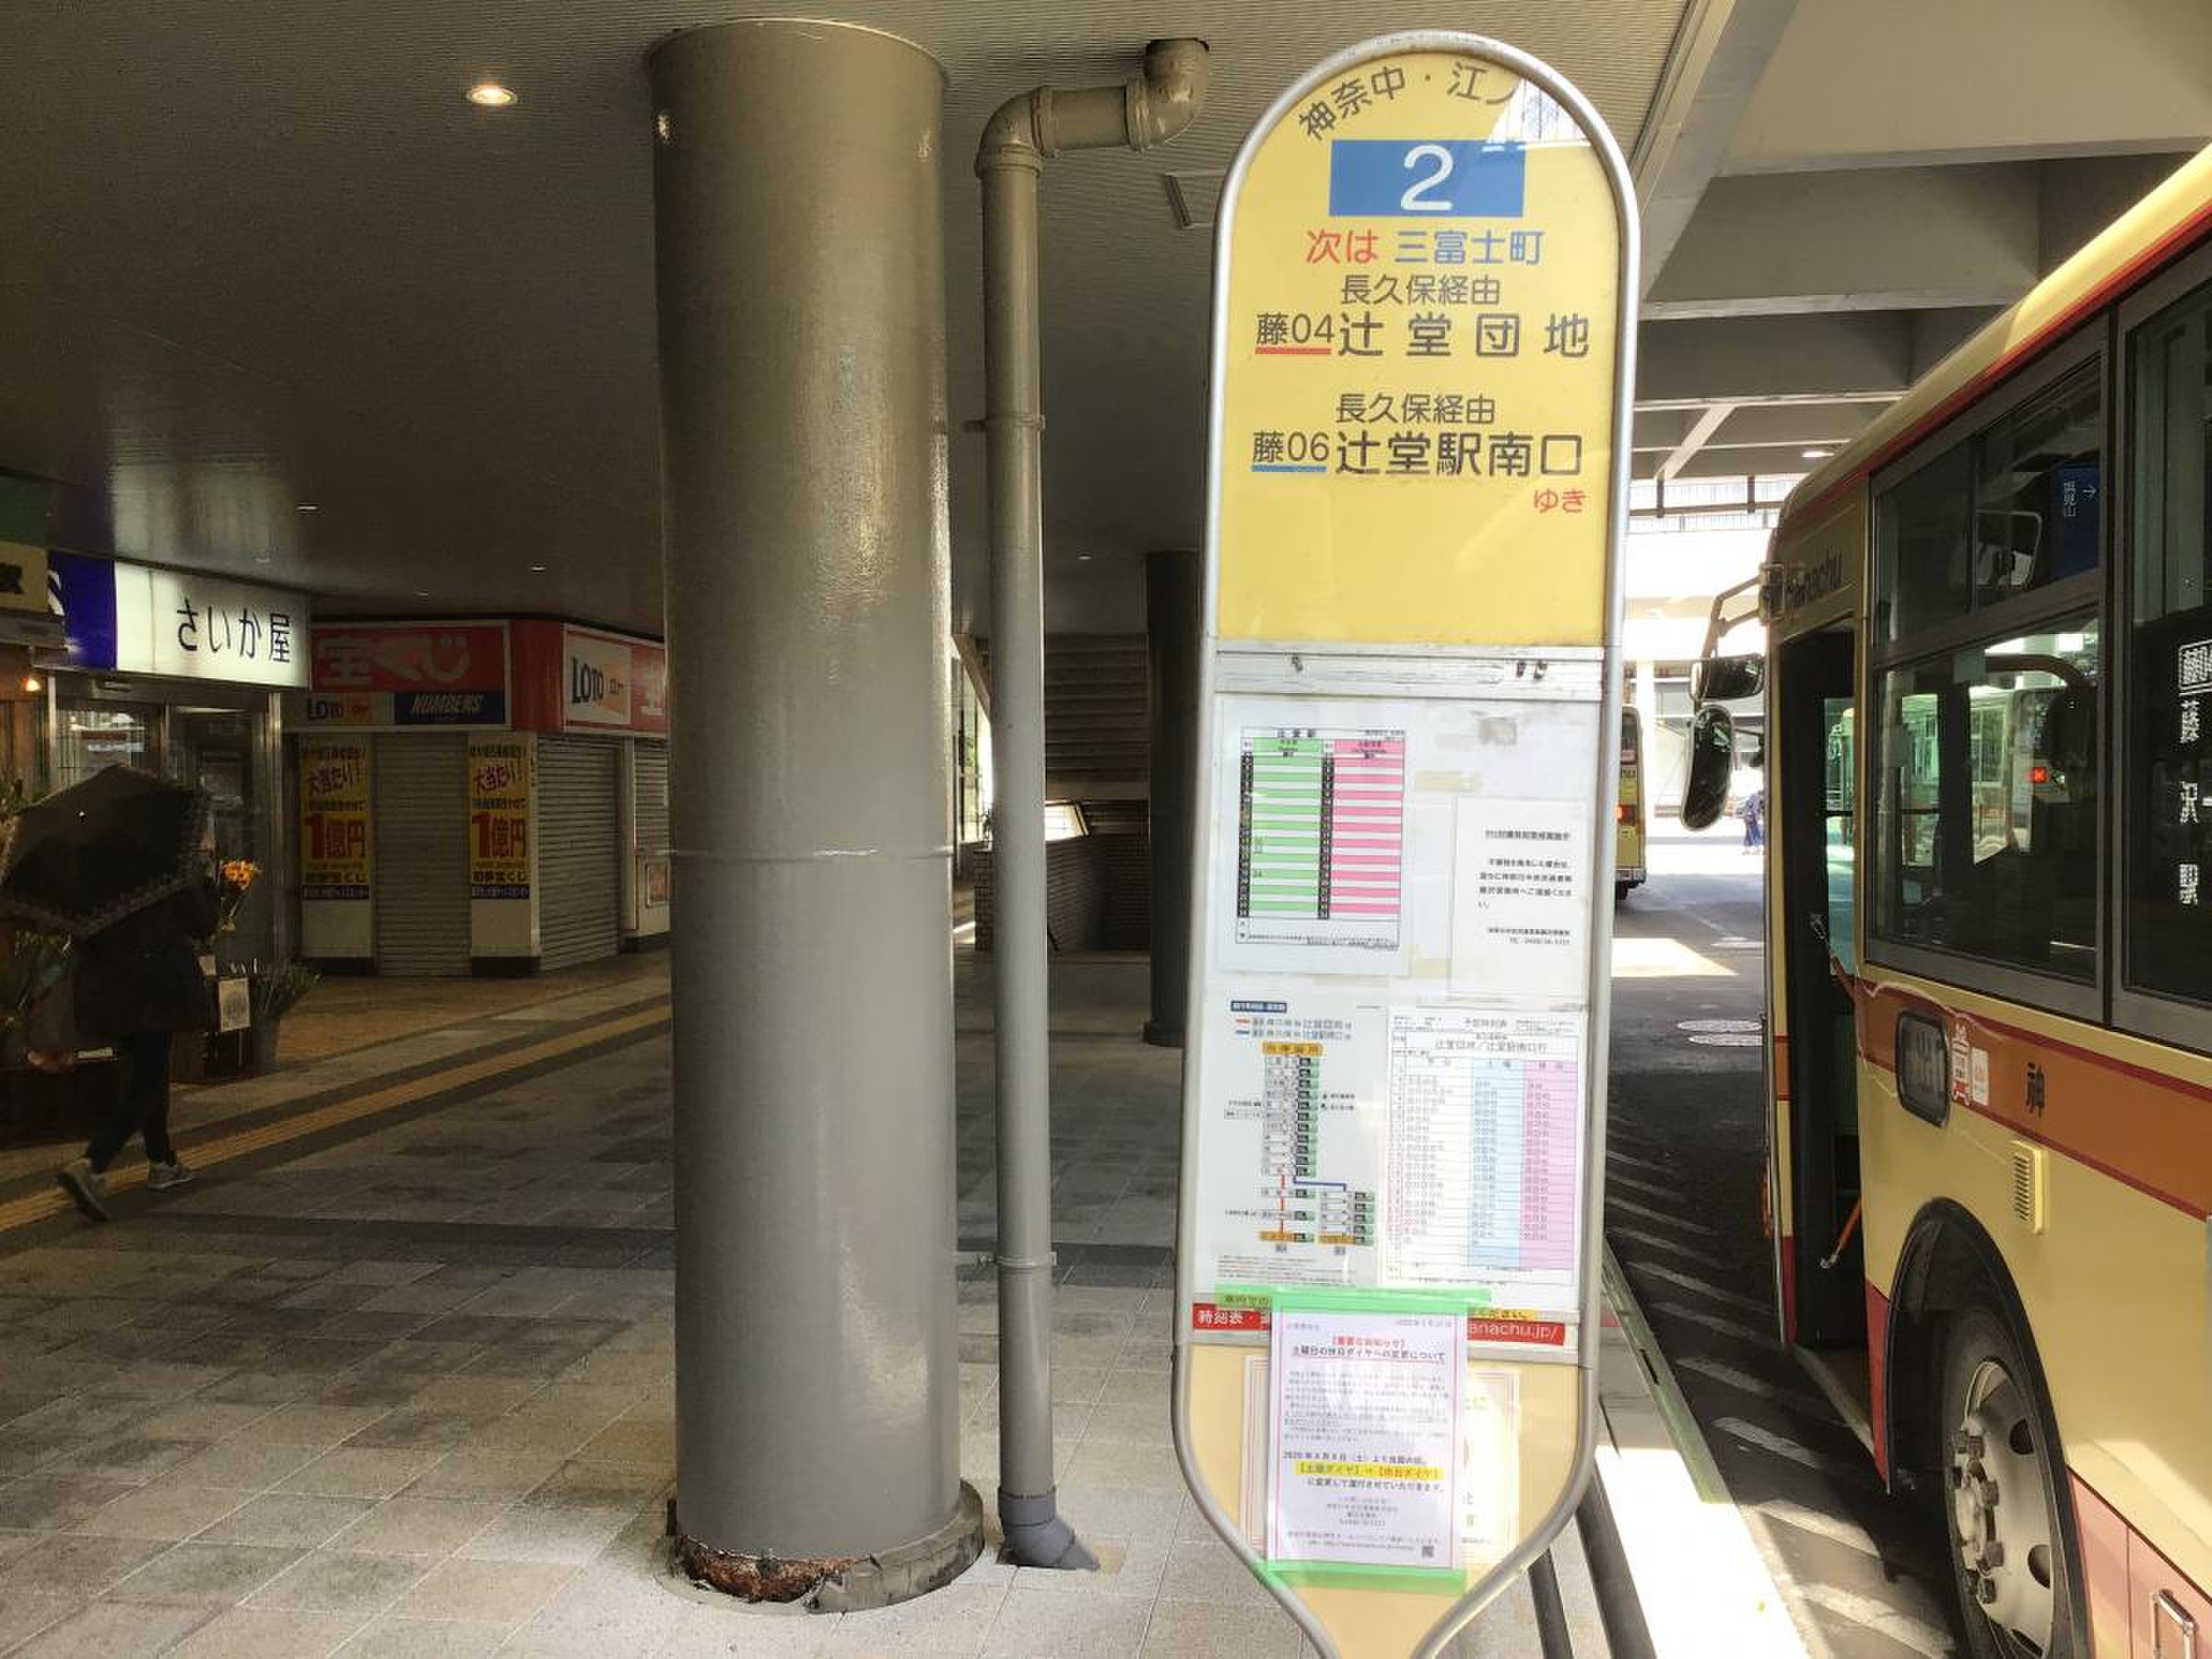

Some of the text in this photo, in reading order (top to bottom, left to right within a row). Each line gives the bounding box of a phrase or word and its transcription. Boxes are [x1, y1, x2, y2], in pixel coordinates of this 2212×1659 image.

[1399, 145, 1454, 212] 2
[1306, 229, 1546, 267] 次は 三富士町
[1340, 274, 1500, 306] 長久保経由
[1255, 312, 1591, 359] 藤04 辻堂団地
[1335, 393, 1496, 425] 長久保経由
[1252, 429, 1583, 477] 藤06 辻堂駅南口
[1533, 488, 1586, 514] ゆき
[176, 596, 291, 665] さいか屋
[316, 633, 473, 686] 宝くじ
[571, 656, 605, 705] LOTO
[2026, 1061, 2046, 1120] 神
